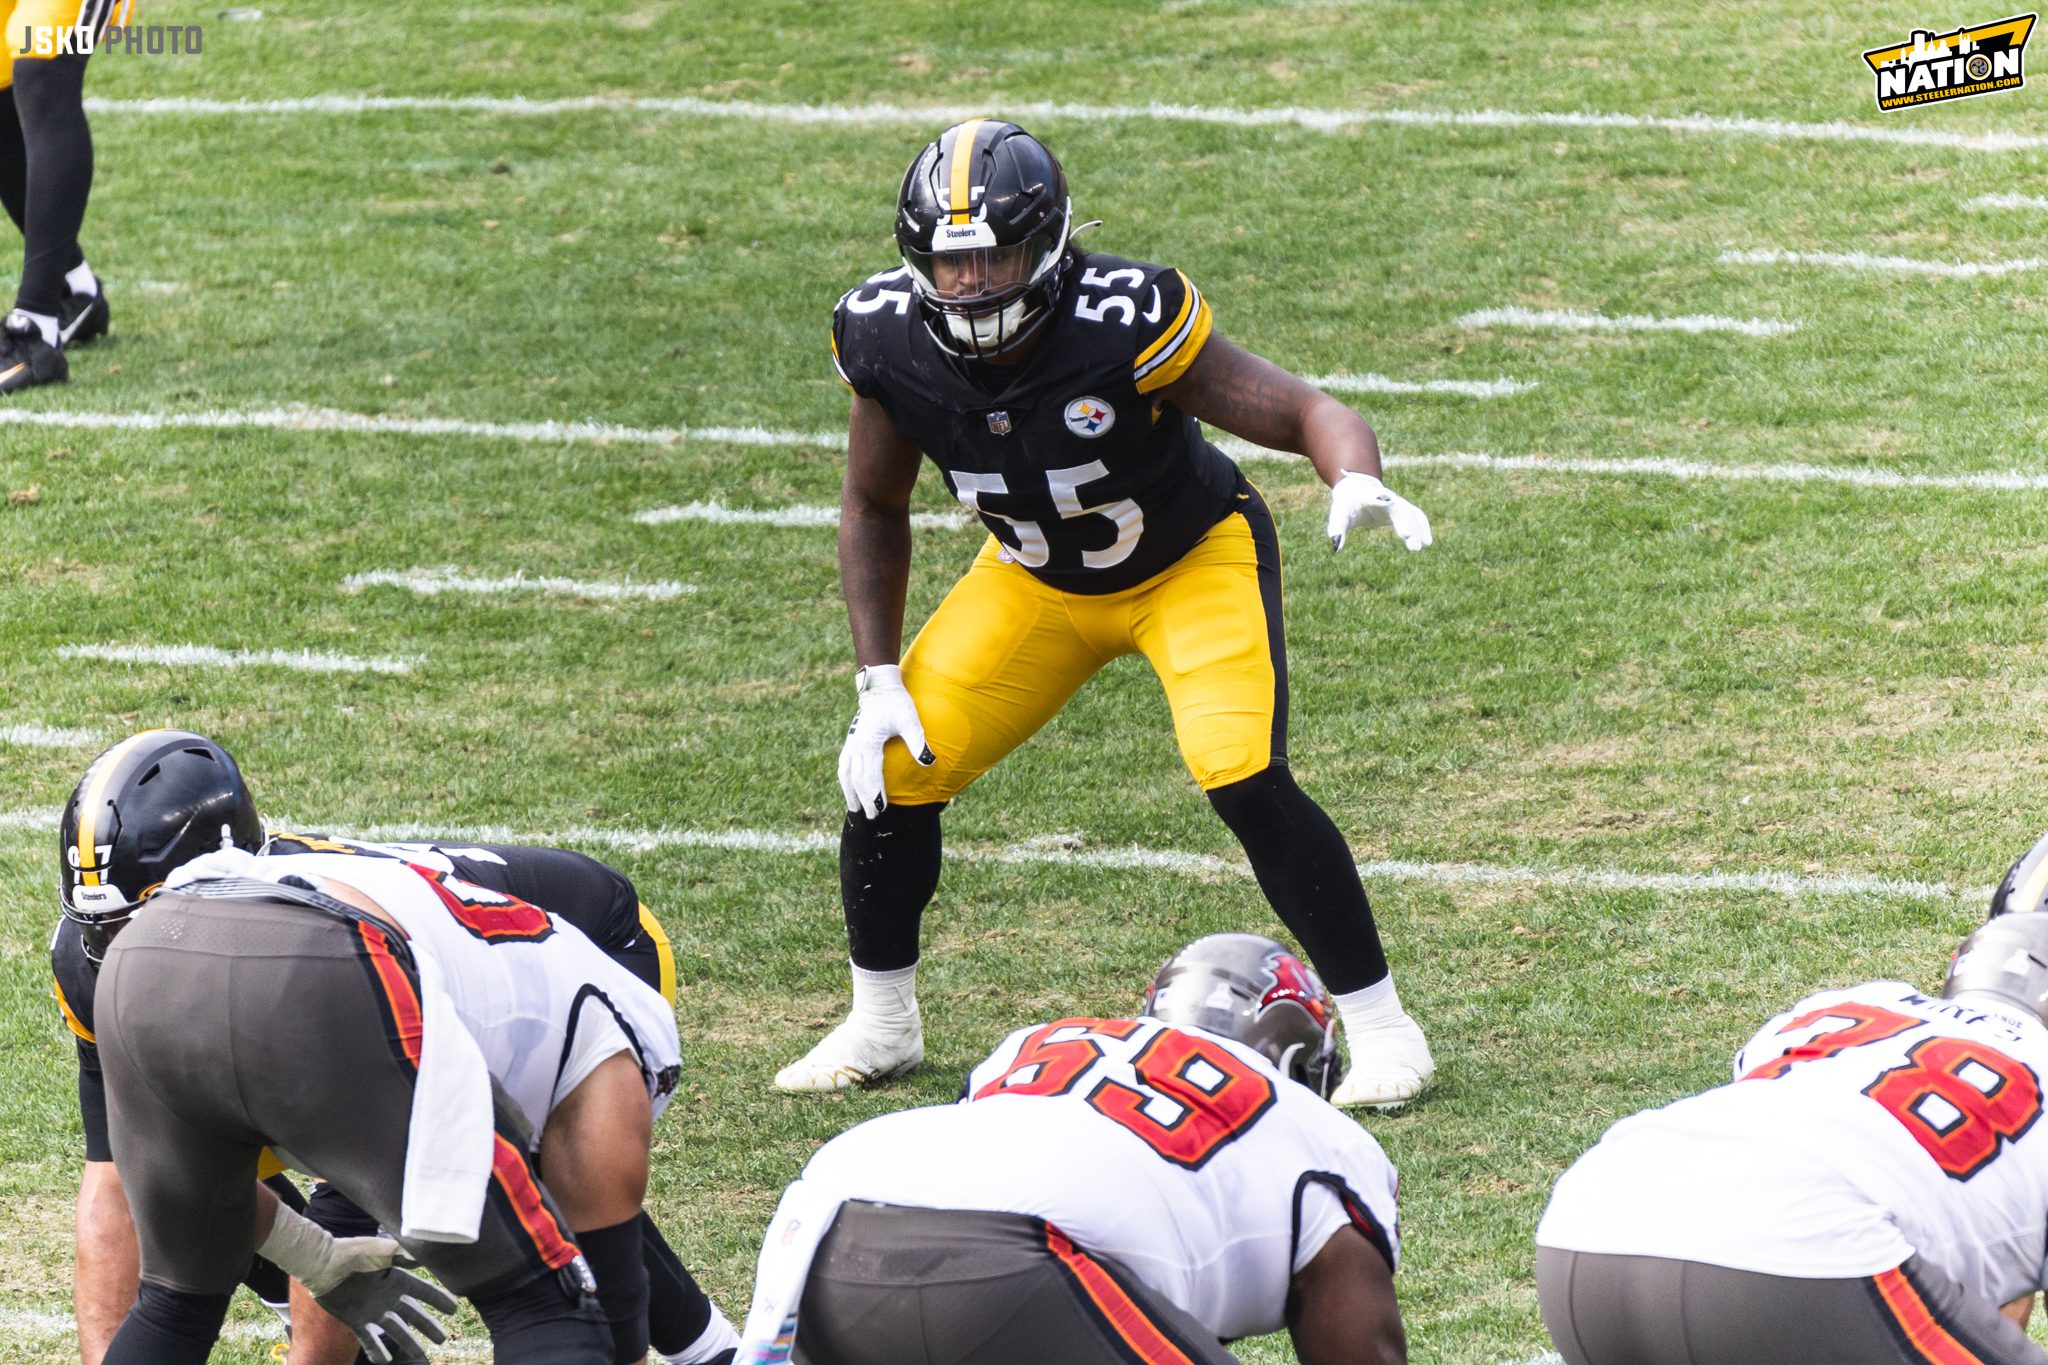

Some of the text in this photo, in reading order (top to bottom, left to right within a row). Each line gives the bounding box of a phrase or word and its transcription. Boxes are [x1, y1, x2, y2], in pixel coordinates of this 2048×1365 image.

[946, 228, 976, 238] Steelers
[1074, 266, 1145, 326] 55
[949, 459, 1144, 568] 55
